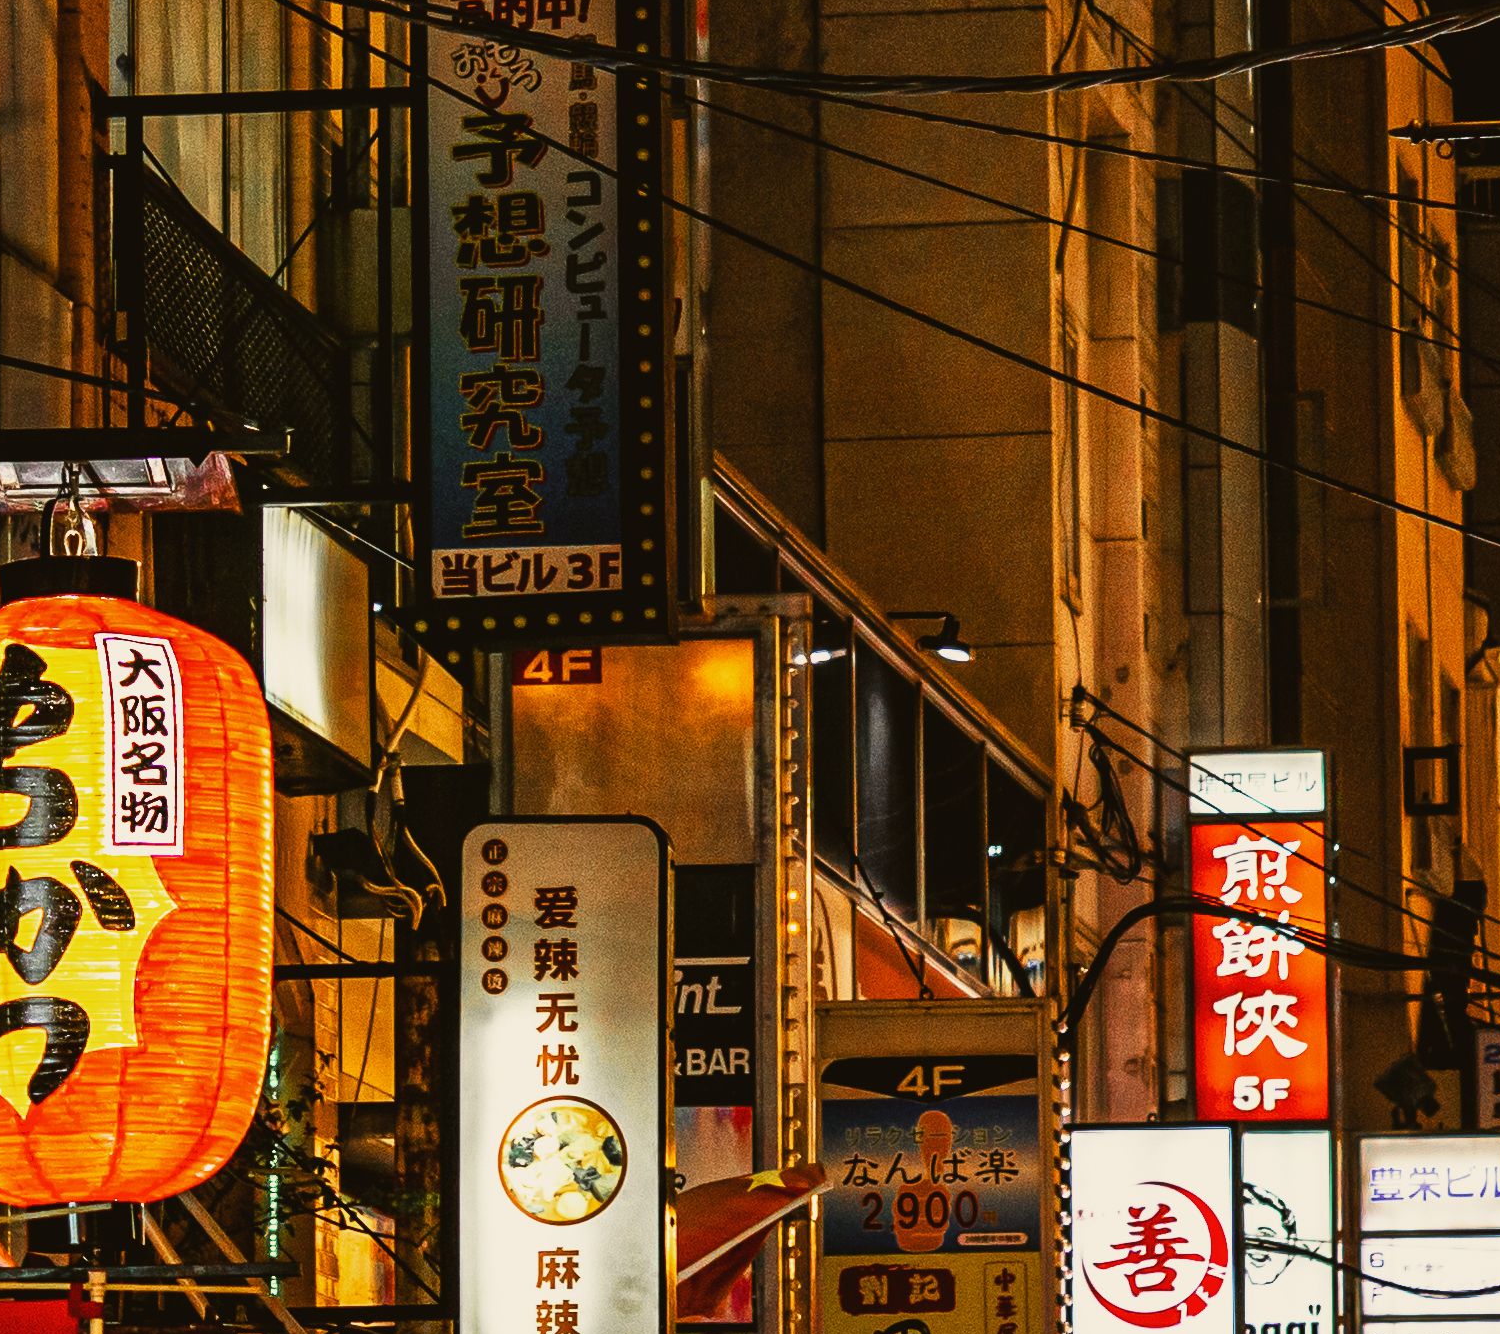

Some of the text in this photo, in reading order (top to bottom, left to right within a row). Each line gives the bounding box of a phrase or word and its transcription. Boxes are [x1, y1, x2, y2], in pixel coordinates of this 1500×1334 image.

[450, 112, 551, 540] 予想研究室
[439, 549, 621, 598] 当ビル 3F
[523, 650, 595, 684] 4F
[116, 647, 171, 836] 大阪名物
[533, 884, 580, 1088] 爱辣无忧
[896, 1064, 967, 1099] 4F
[1232, 1075, 1291, 1112] 5F
[841, 1149, 1020, 1187] なんば楽
[1092, 1202, 1206, 1298] 善
